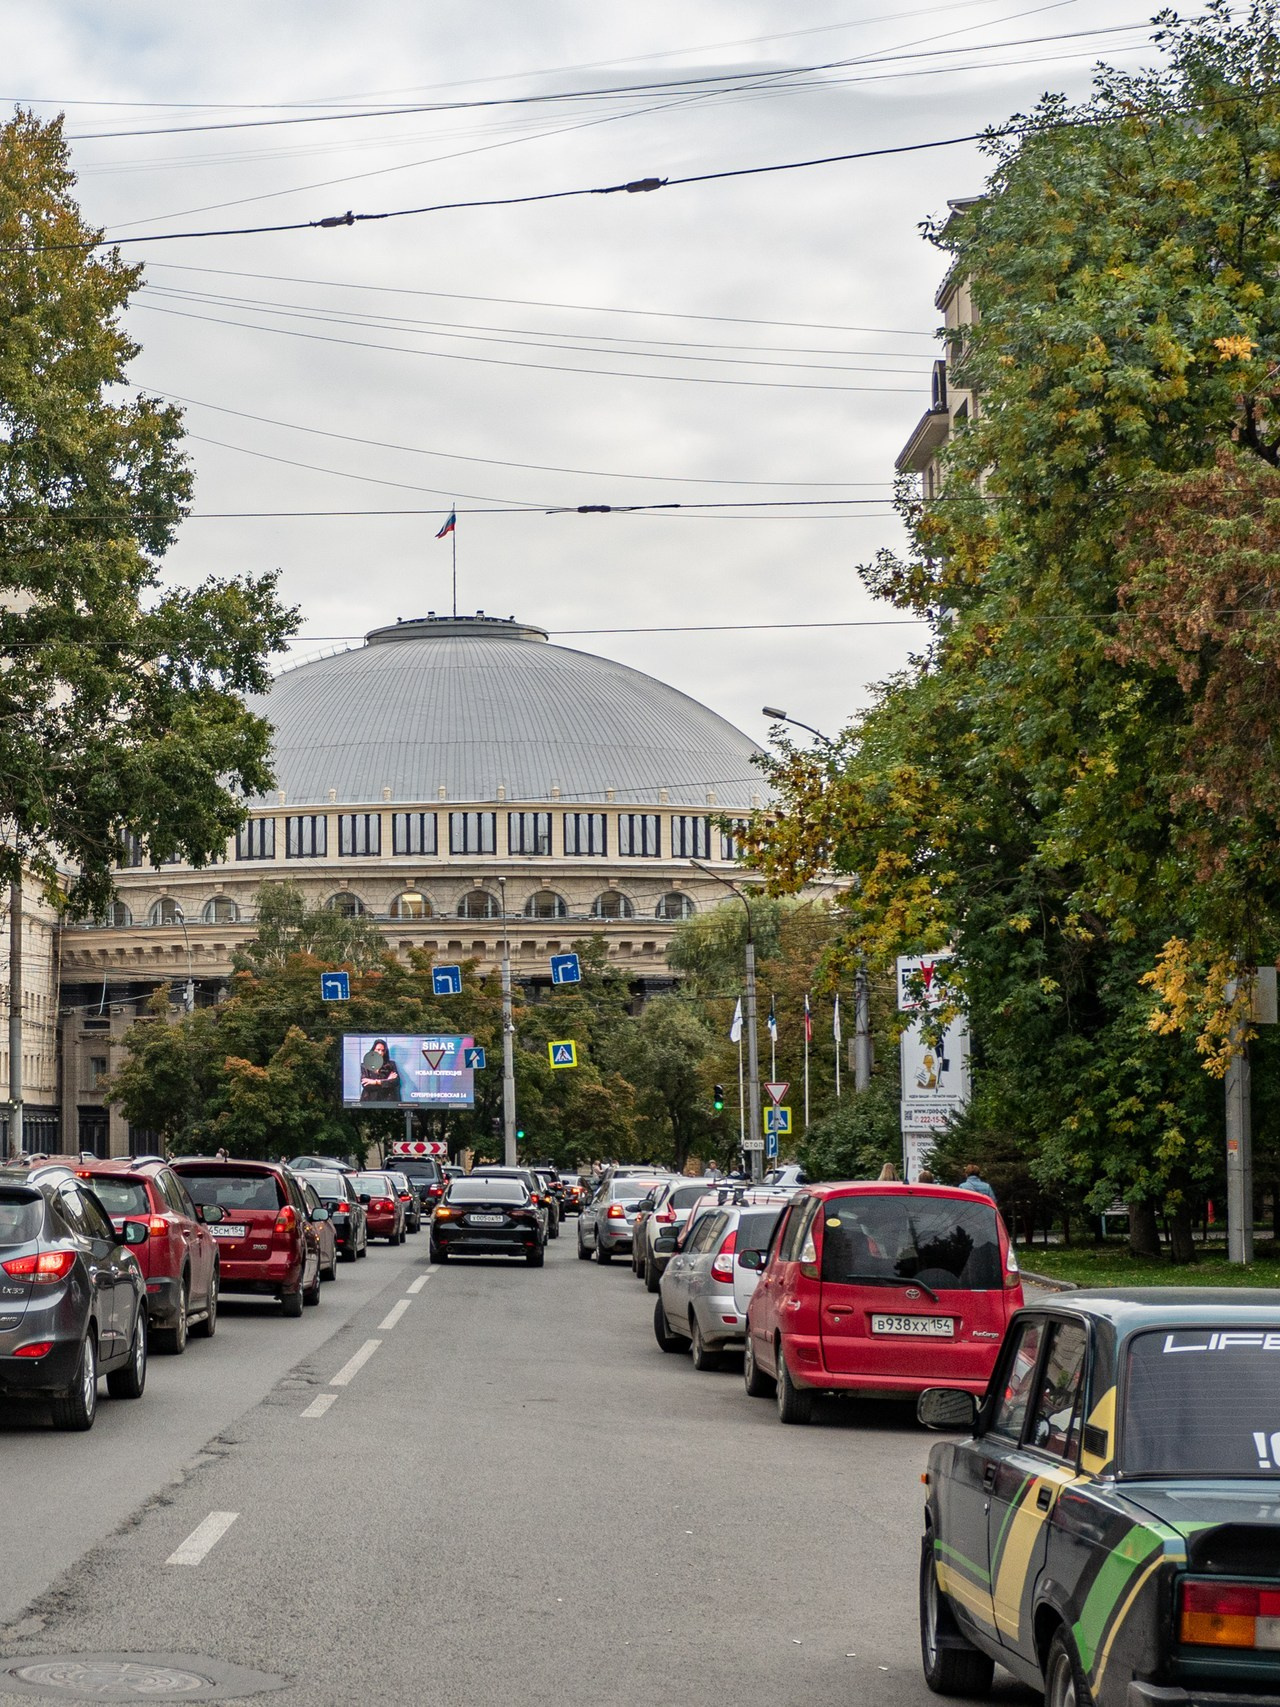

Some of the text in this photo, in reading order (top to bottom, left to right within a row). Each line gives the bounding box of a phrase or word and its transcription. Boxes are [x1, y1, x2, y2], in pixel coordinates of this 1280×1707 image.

[422, 1042, 455, 1050] SINAR
[744, 1140, 764, 1148] СТОП
[931, 1319, 950, 1329] 154
